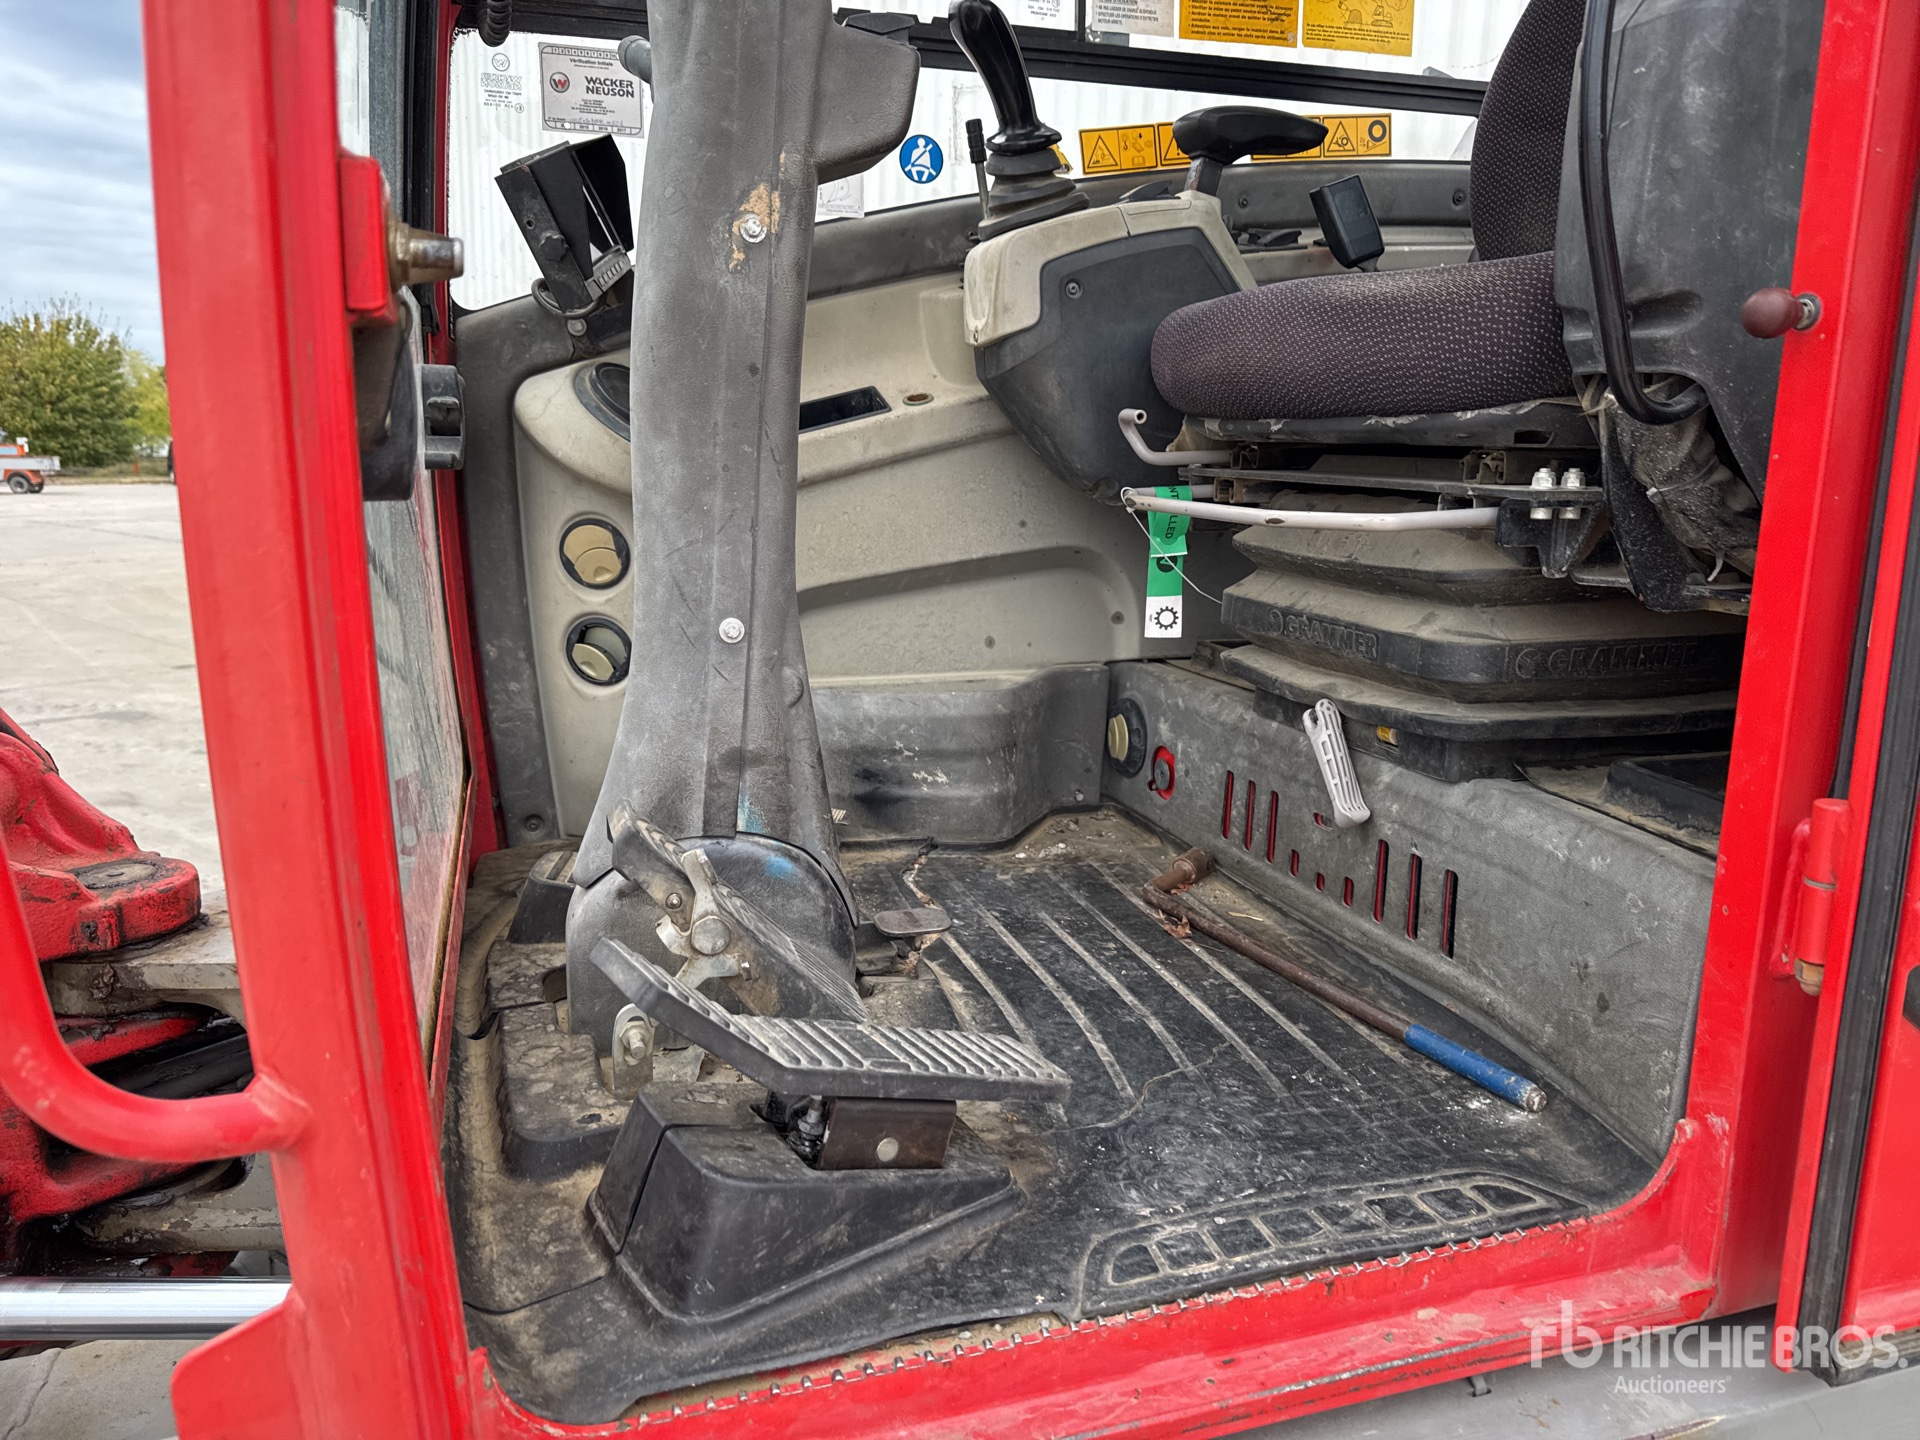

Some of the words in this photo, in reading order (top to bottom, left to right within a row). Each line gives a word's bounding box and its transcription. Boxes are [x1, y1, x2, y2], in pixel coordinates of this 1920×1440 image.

[569, 57, 597, 65] Vérification
[584, 75, 634, 89] WACKER
[585, 84, 635, 98] NEUSON
[1285, 614, 1379, 660] GRAMMER
[1547, 641, 1697, 673] GRAMMER
